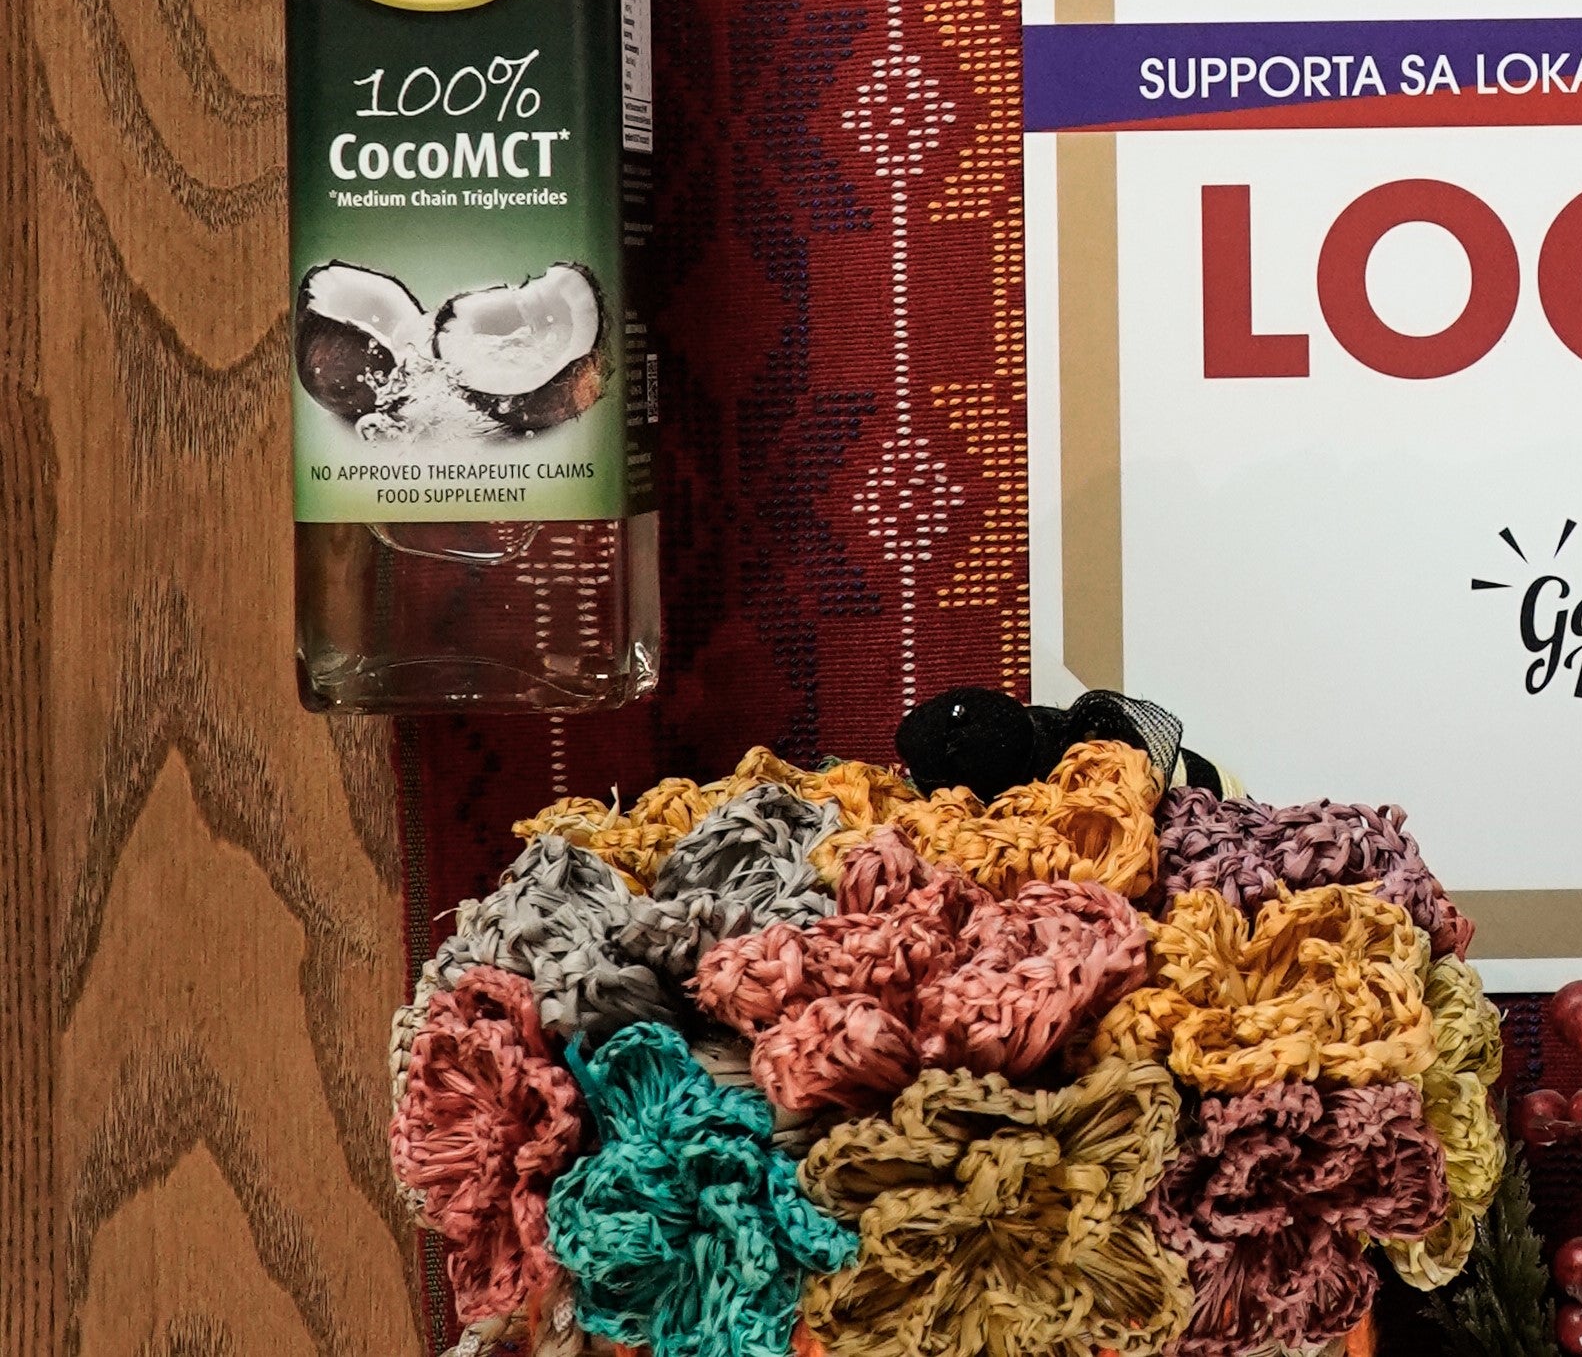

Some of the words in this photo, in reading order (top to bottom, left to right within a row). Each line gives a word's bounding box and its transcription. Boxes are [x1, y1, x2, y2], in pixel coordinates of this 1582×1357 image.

[353, 49, 541, 122] 100%
[1139, 55, 1387, 100] SUPPORTA
[1400, 53, 1461, 97] SA
[411, 190, 457, 206] Chain
[462, 188, 568, 210] Triglycerides
[311, 466, 332, 481] NO
[337, 465, 421, 481] APPROVED
[428, 463, 531, 480] THERAPEUTIC
[536, 463, 595, 479] CLAIMS
[377, 488, 420, 503] FOOD
[424, 487, 527, 503] SUPPLEMENT
